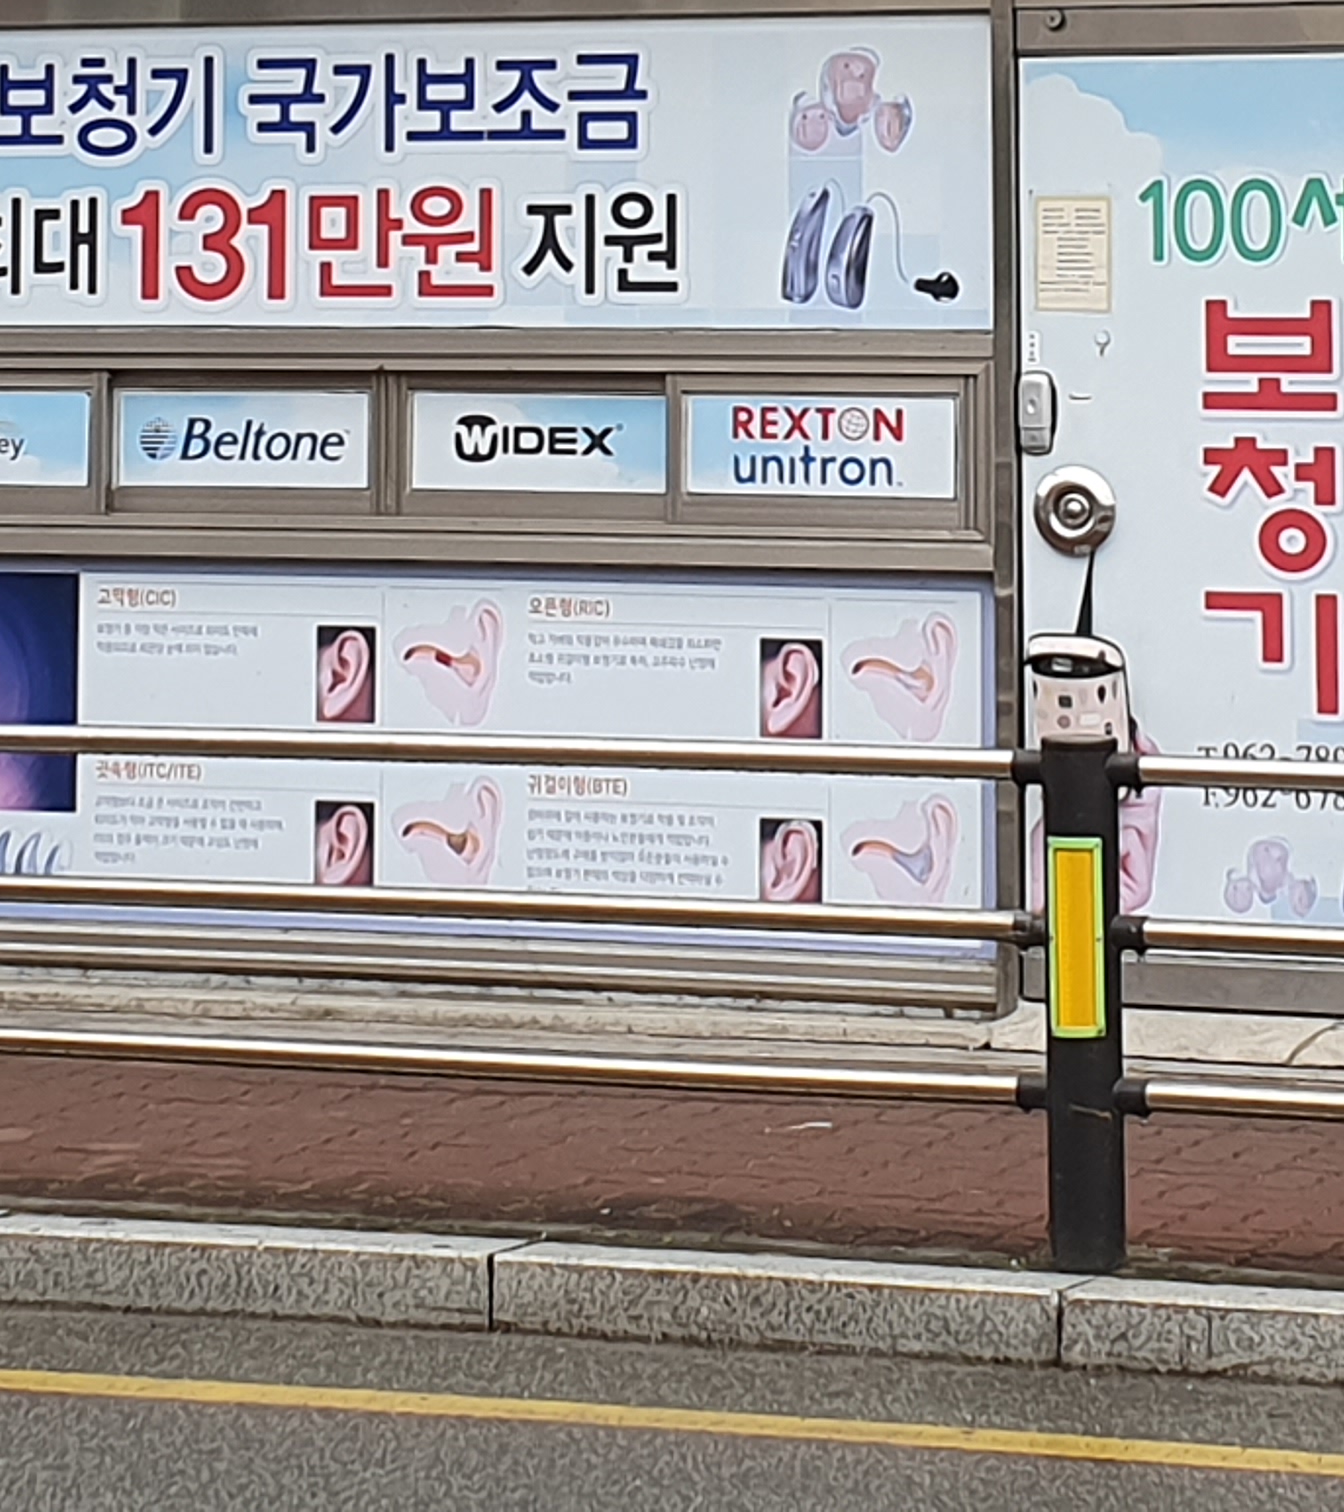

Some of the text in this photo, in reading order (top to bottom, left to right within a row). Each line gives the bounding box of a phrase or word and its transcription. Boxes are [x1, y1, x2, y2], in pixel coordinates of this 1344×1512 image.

[246, 51, 648, 155] 국가보조금
[118, 184, 494, 302] 131만원
[520, 189, 681, 299] 지원
[180, 417, 345, 464] Beltone
[455, 414, 616, 463] WIDEX
[730, 405, 905, 443] REXTON
[733, 445, 895, 487] unitron
[1202, 298, 1339, 716] 보청기
[528, 596, 610, 618] 오픈형(RIC)
[528, 774, 627, 797] 귀걸이형(BTE)
